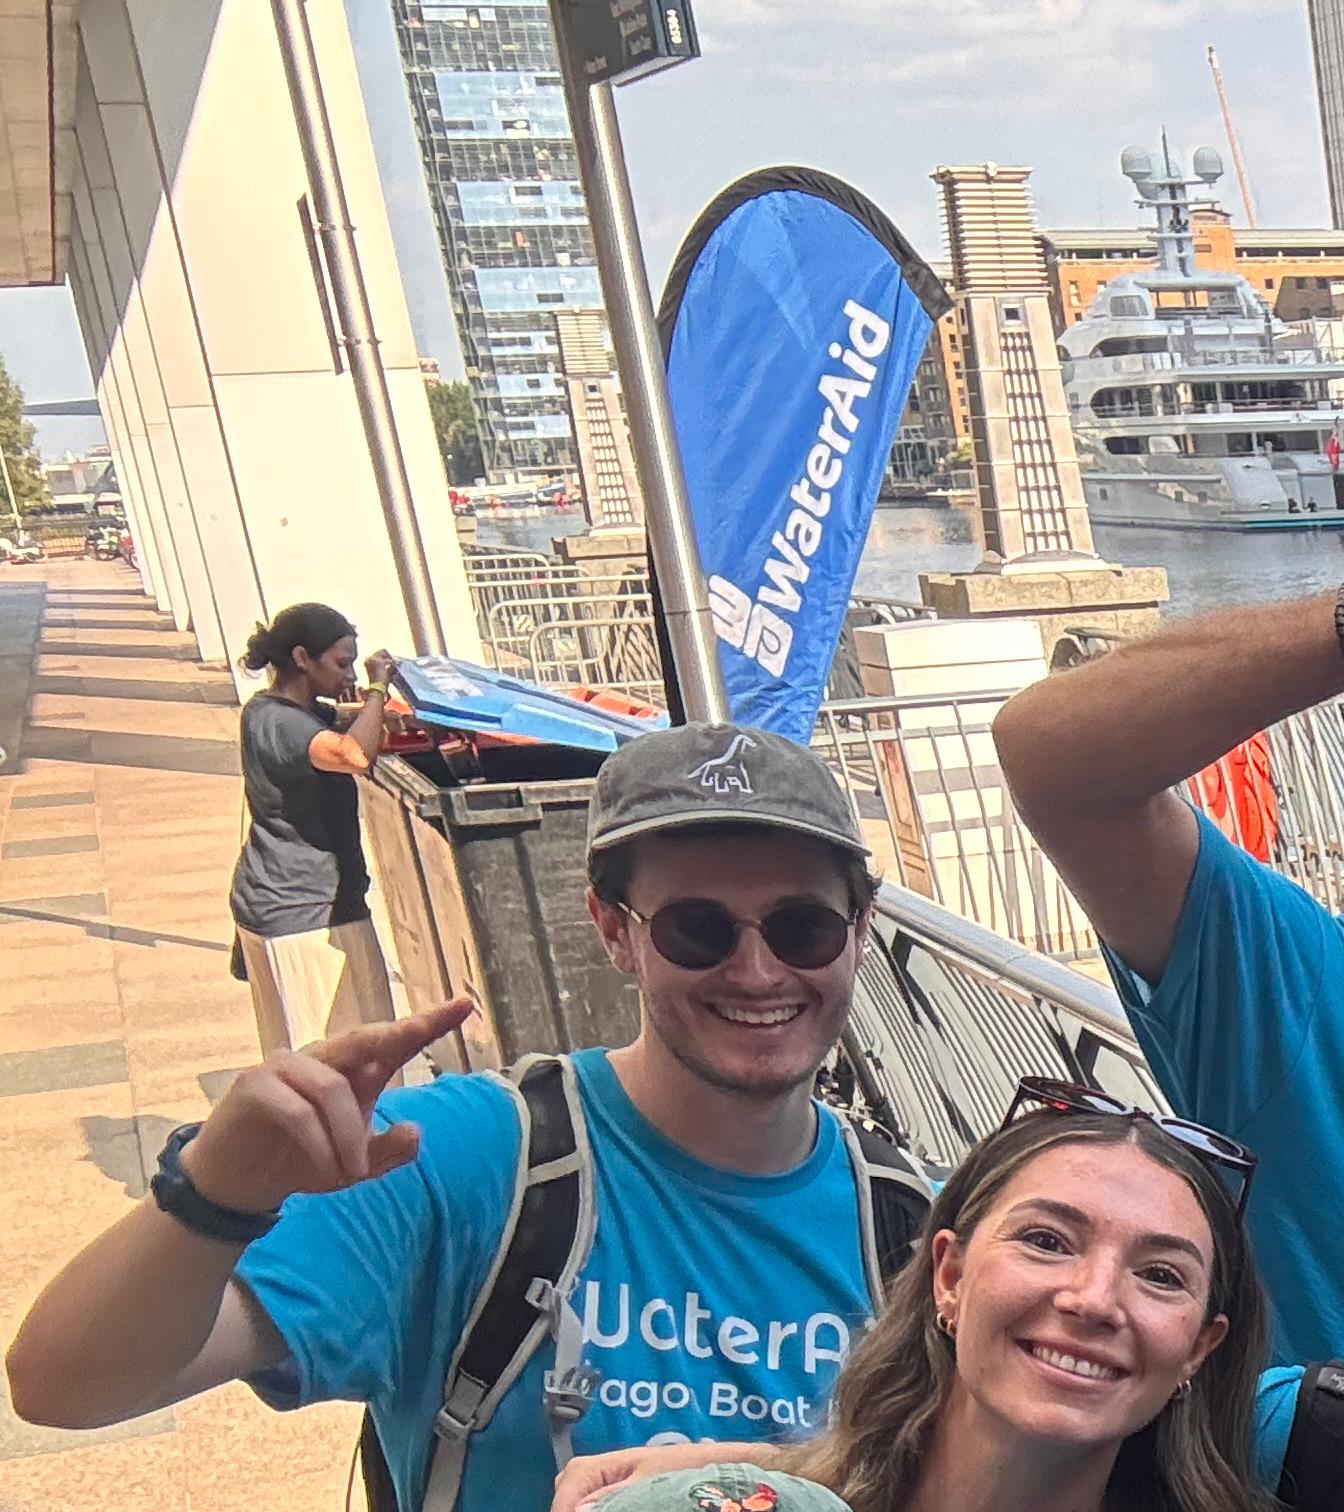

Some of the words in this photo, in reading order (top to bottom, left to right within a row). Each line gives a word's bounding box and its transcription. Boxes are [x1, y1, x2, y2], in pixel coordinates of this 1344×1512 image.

[758, 299, 890, 612] WaterAid
[581, 1280, 850, 1374] WaterA
[708, 1382, 813, 1428] Boat
